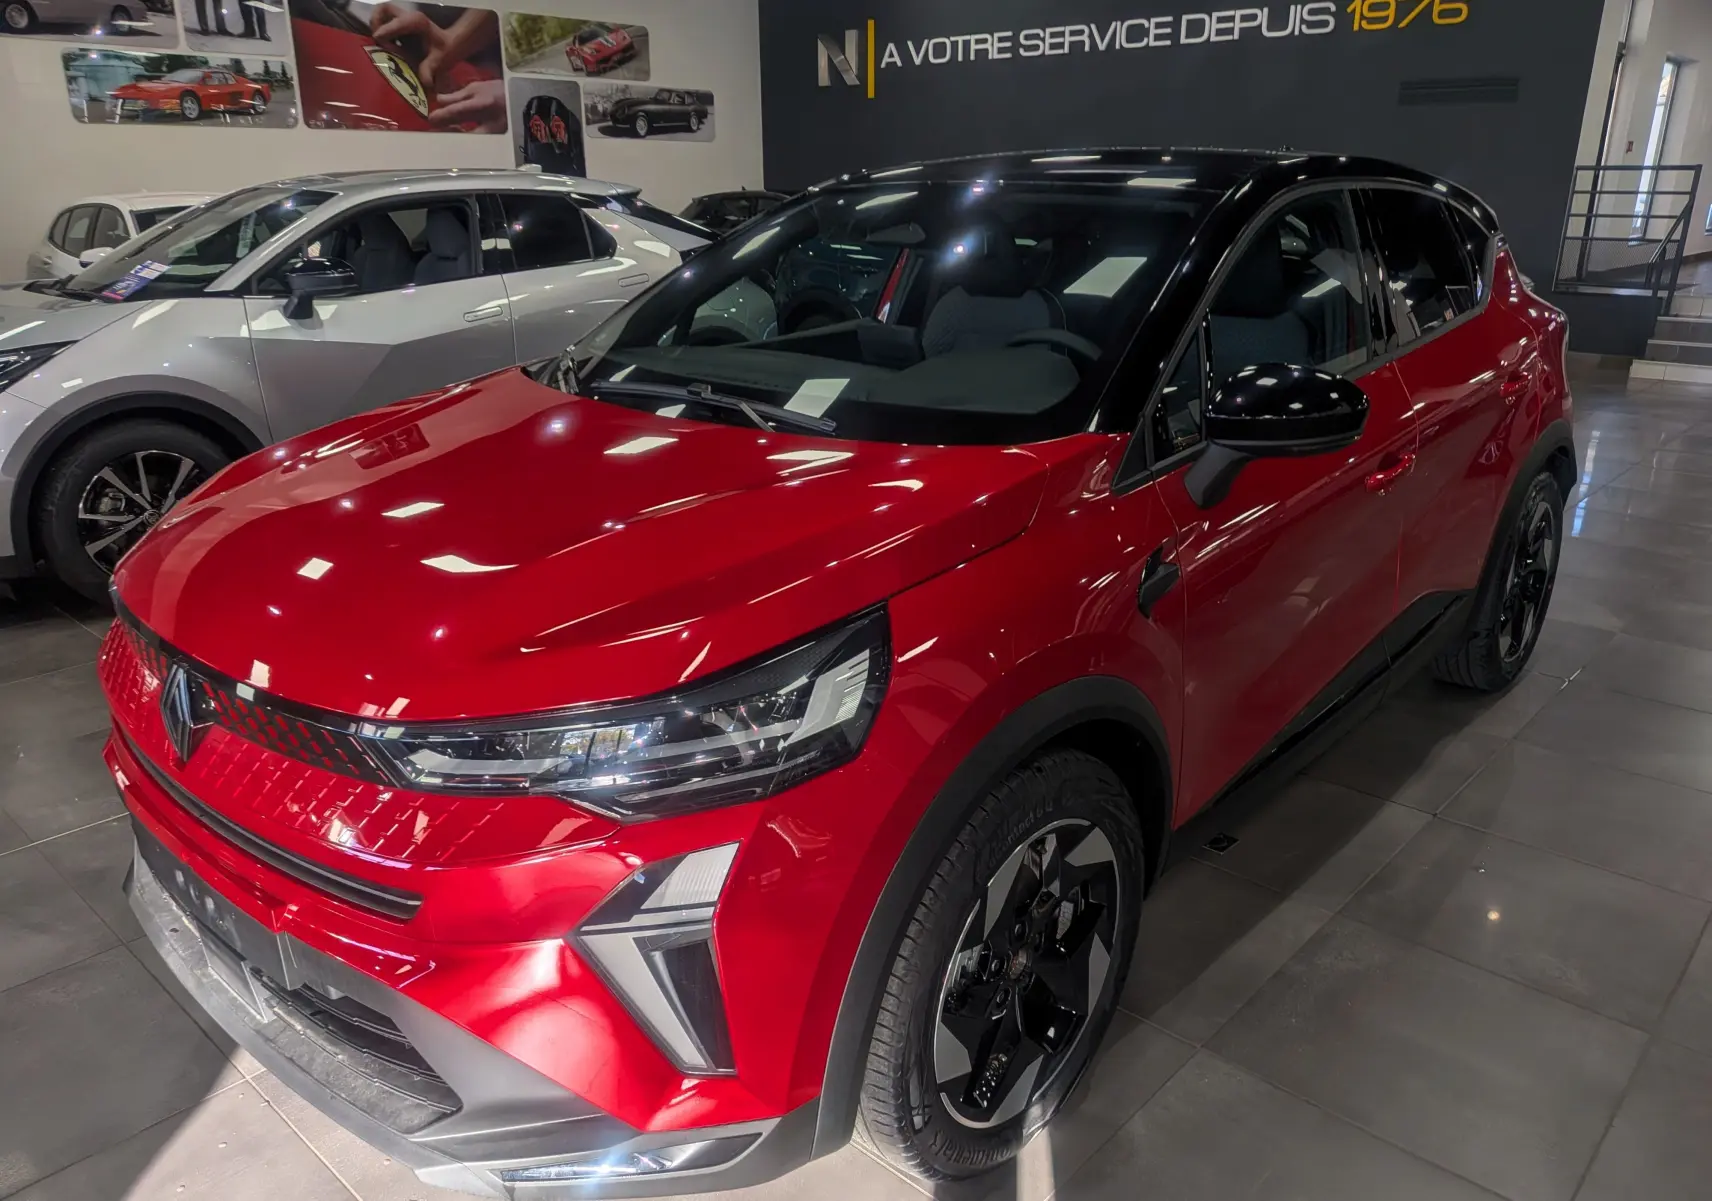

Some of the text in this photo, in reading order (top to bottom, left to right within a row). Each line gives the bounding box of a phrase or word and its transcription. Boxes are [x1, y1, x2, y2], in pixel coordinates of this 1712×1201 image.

[818, 29, 860, 87] N
[881, 43, 902, 69] A
[907, 31, 1013, 66] VOTRE
[1019, 16, 1173, 57] SERVICE
[1180, 1, 1337, 45] DEPUIS
